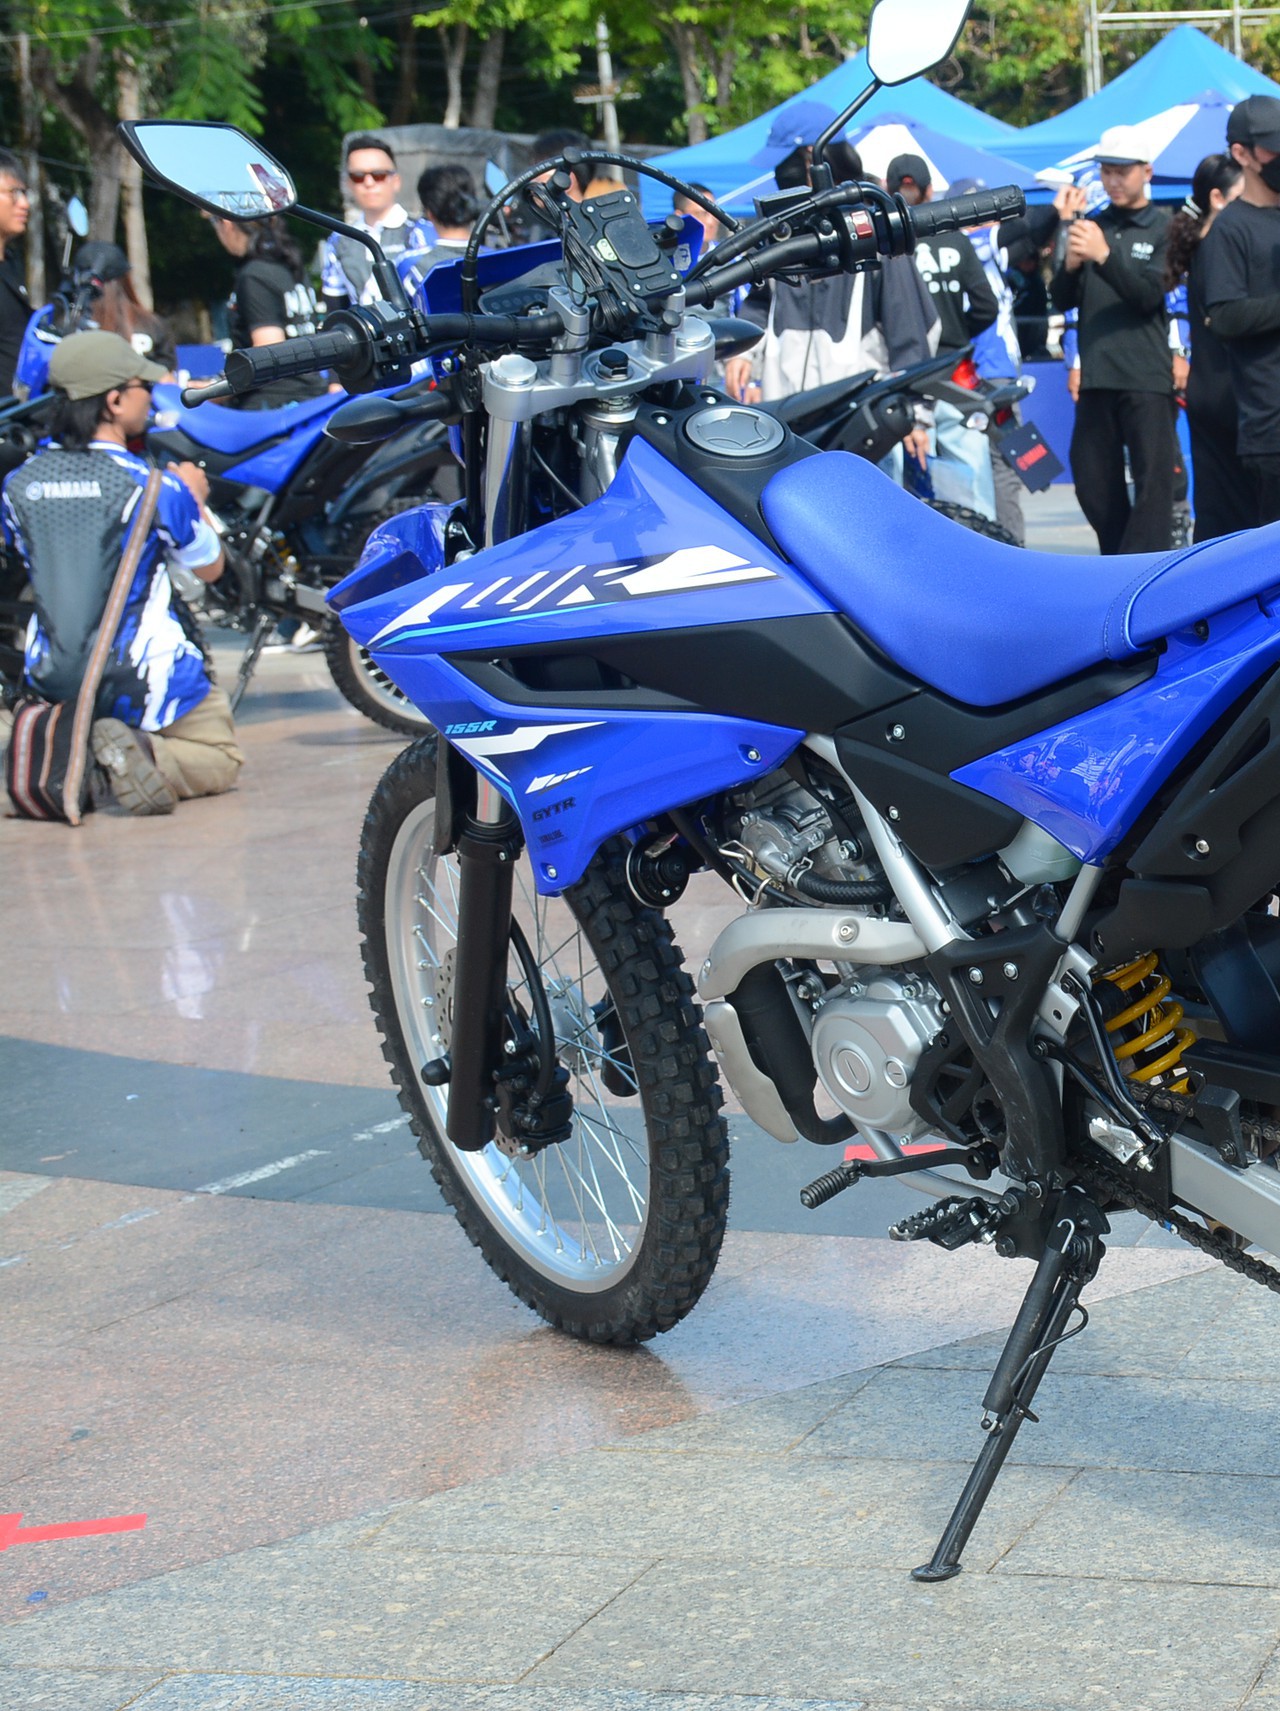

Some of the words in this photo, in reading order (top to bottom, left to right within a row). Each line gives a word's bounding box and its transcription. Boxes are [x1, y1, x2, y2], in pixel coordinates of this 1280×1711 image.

[42, 480, 102, 499] YAMAHA
[445, 719, 498, 735] 155R
[531, 796, 577, 823] GYTR
